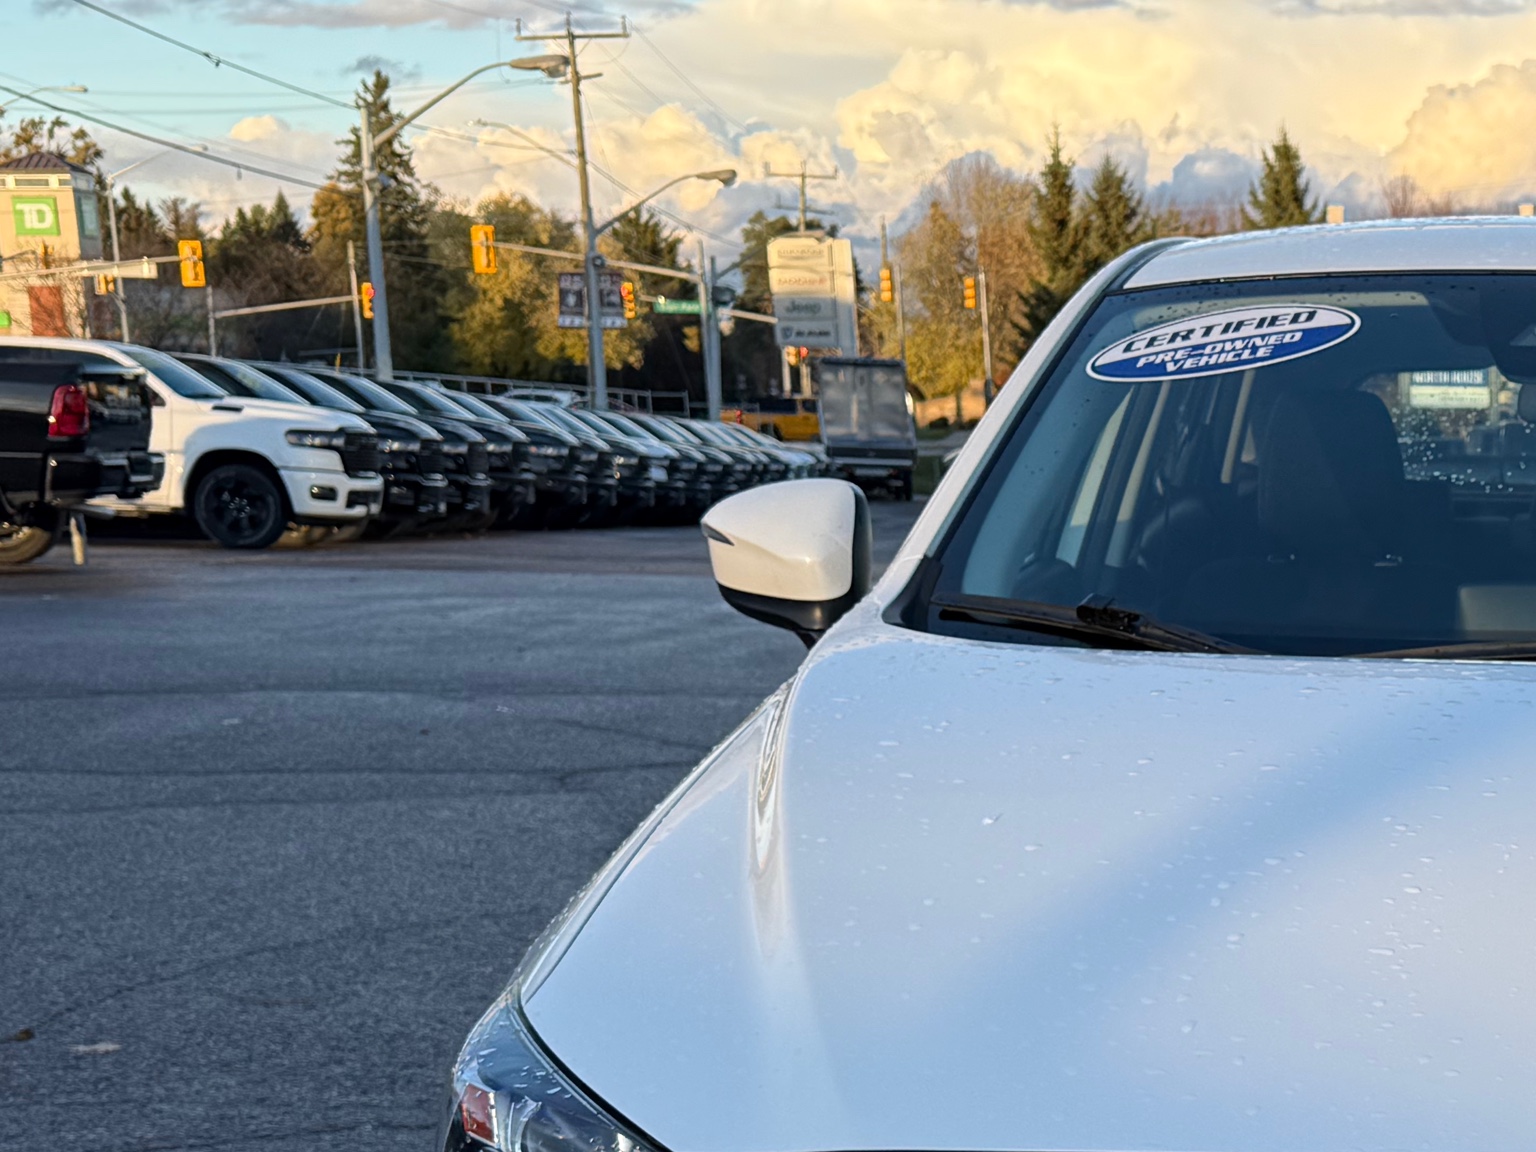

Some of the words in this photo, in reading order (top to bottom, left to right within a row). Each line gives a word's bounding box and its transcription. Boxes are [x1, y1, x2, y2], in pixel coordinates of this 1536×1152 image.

[15, 203, 53, 229] TD
[1121, 309, 1318, 354] CERTIFIED
[1135, 331, 1304, 369] PRE-OWNED
[1165, 345, 1275, 373] VEHICLE
